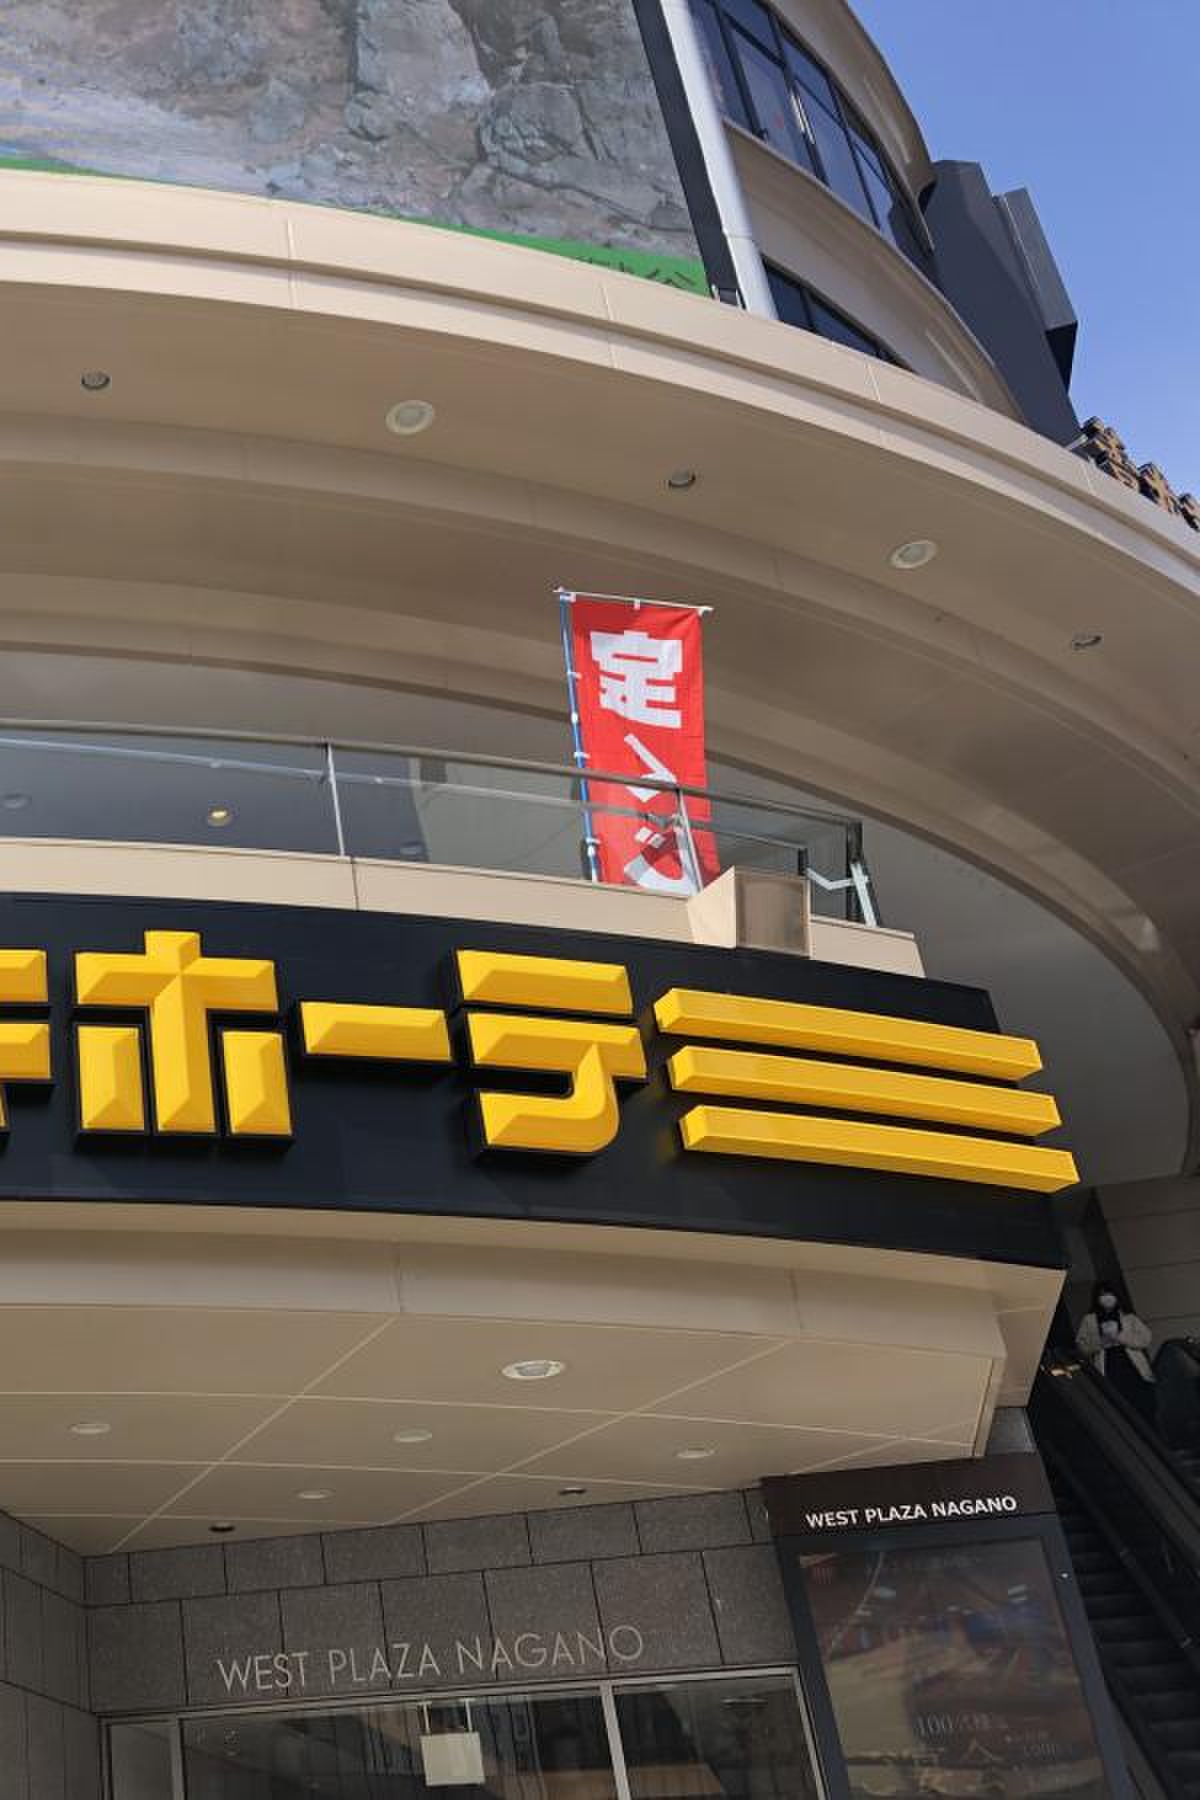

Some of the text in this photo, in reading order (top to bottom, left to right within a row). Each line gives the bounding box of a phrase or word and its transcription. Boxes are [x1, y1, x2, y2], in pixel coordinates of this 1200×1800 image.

[805, 1495, 1018, 1529] WEST PLAZA NAGANO
[217, 1625, 644, 1693] WEST PLAZA NAGANO
